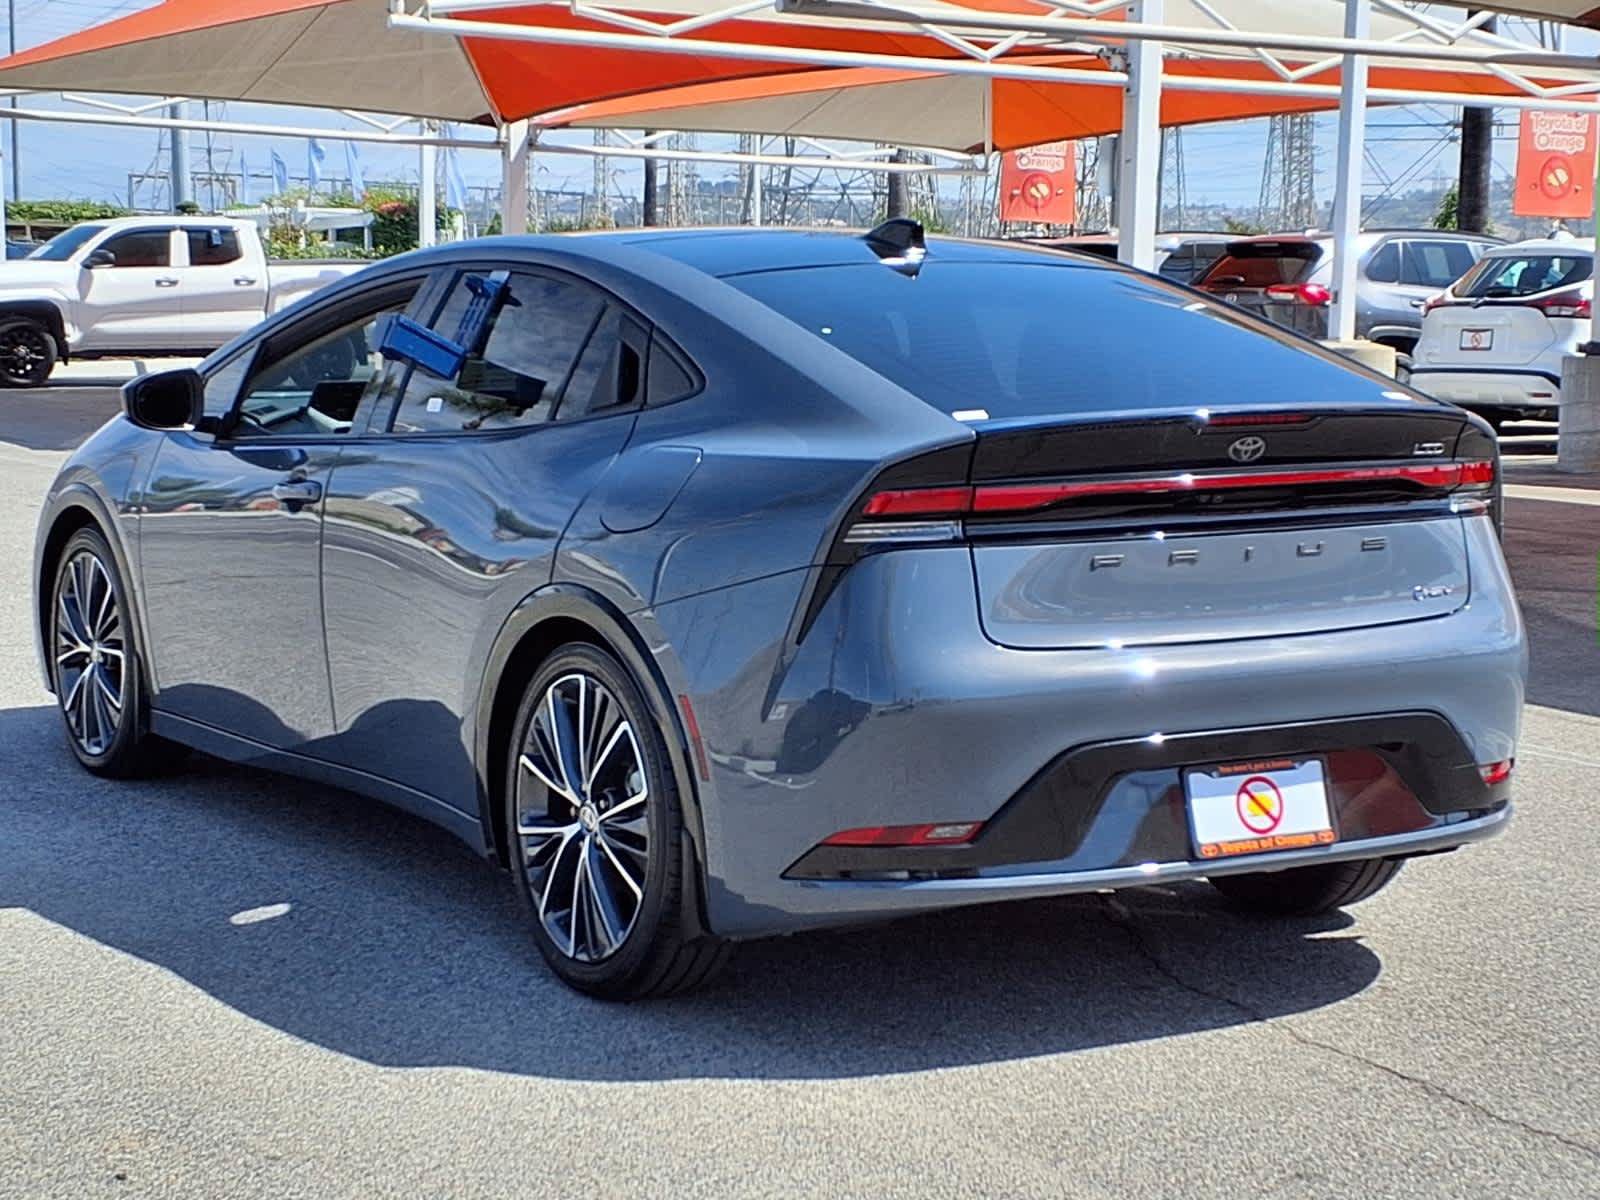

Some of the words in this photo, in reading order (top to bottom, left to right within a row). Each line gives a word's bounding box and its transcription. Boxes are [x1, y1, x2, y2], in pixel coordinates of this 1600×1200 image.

[1531, 111, 1574, 133] Toyota
[1534, 131, 1586, 154] Orange
[1089, 536, 1387, 572] PRIUS
